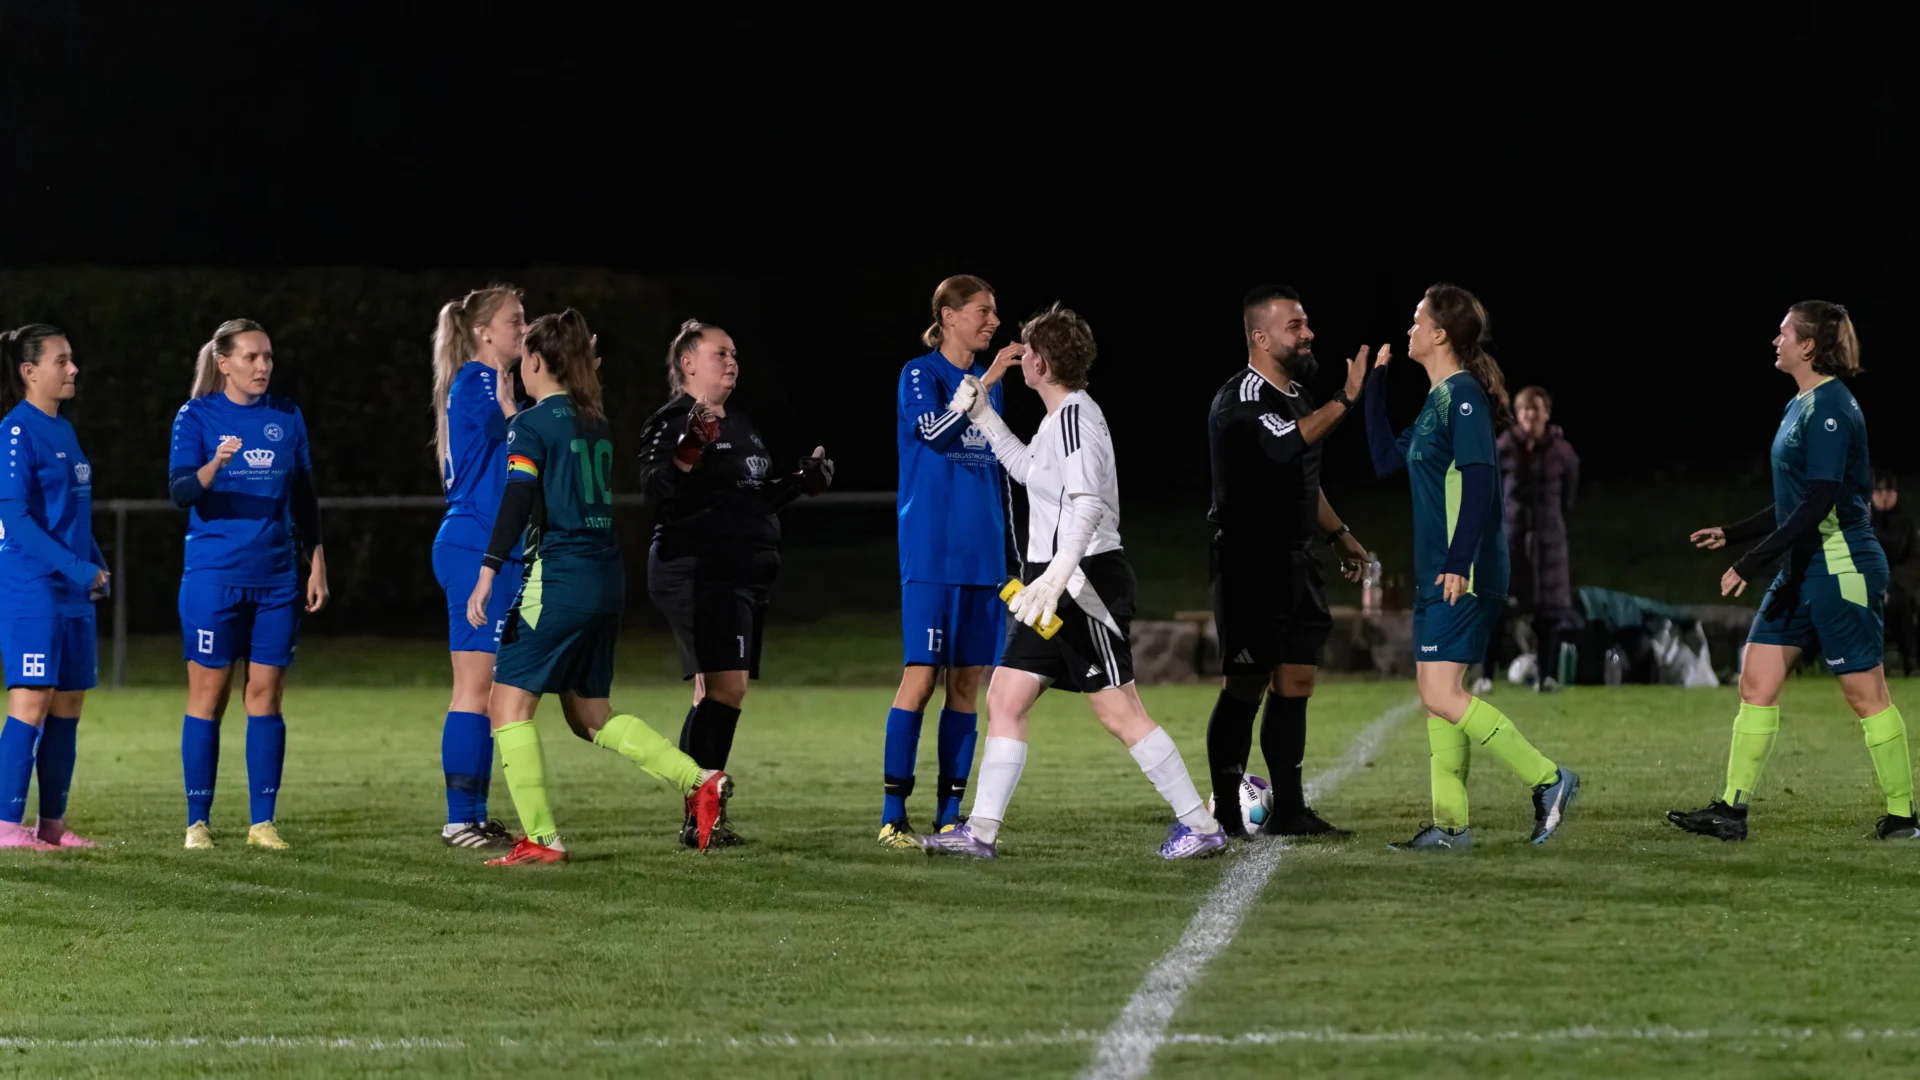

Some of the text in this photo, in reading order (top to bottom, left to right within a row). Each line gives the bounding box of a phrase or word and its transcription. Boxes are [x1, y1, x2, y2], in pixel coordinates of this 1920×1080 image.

[570, 438, 613, 505] 10
[197, 629, 214, 654] 13
[736, 635, 745, 658] 1
[22, 653, 45, 677] 66
